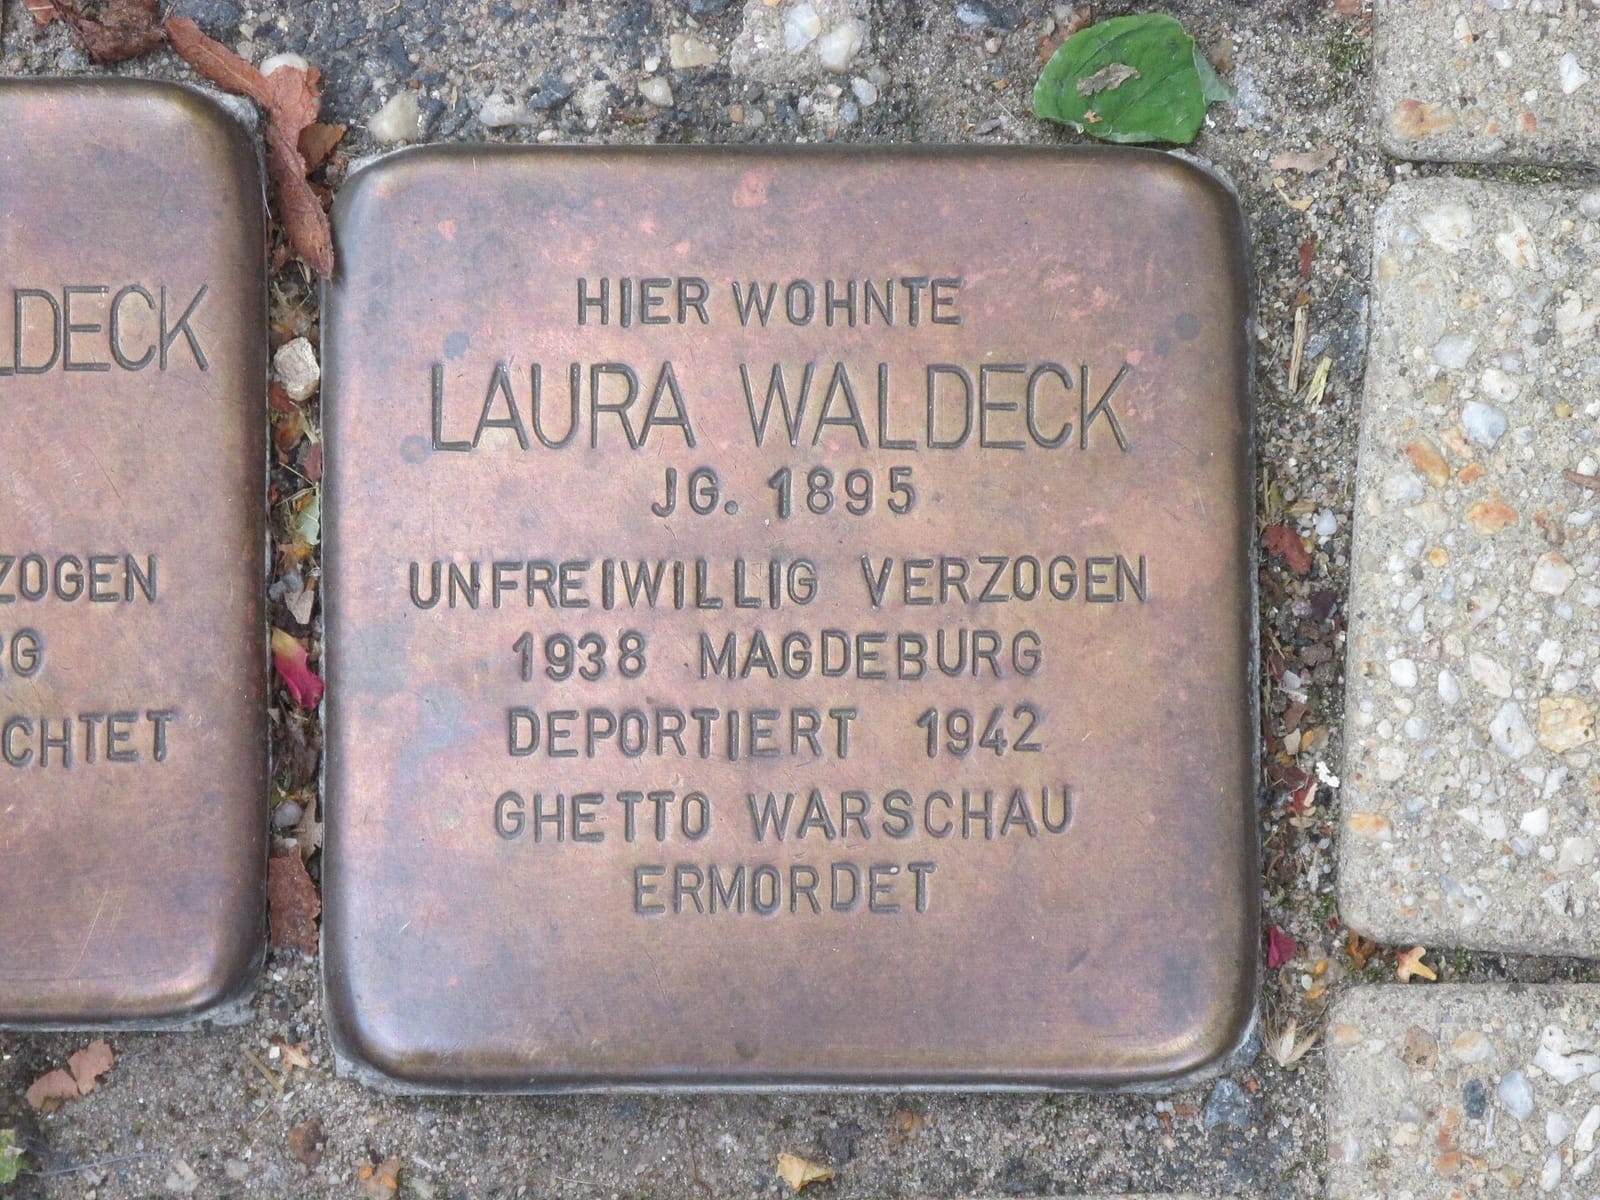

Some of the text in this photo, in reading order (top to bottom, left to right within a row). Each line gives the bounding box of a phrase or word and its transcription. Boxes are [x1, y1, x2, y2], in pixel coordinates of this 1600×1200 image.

[578, 276, 964, 328] HIER WOHNTE
[431, 360, 1133, 452] LAURA WALDECK
[651, 466, 916, 519] JG. 1895
[409, 554, 1148, 610] UNFREIWILLIG VERZOGEN
[512, 629, 1042, 682] 1938 MAGDEBURG
[2, 709, 176, 768] CHTET
[509, 704, 1043, 761] DEPORTIERT 1942
[494, 785, 1076, 842] GHETTO WARSCHAU
[634, 861, 937, 915] ERMORDET
